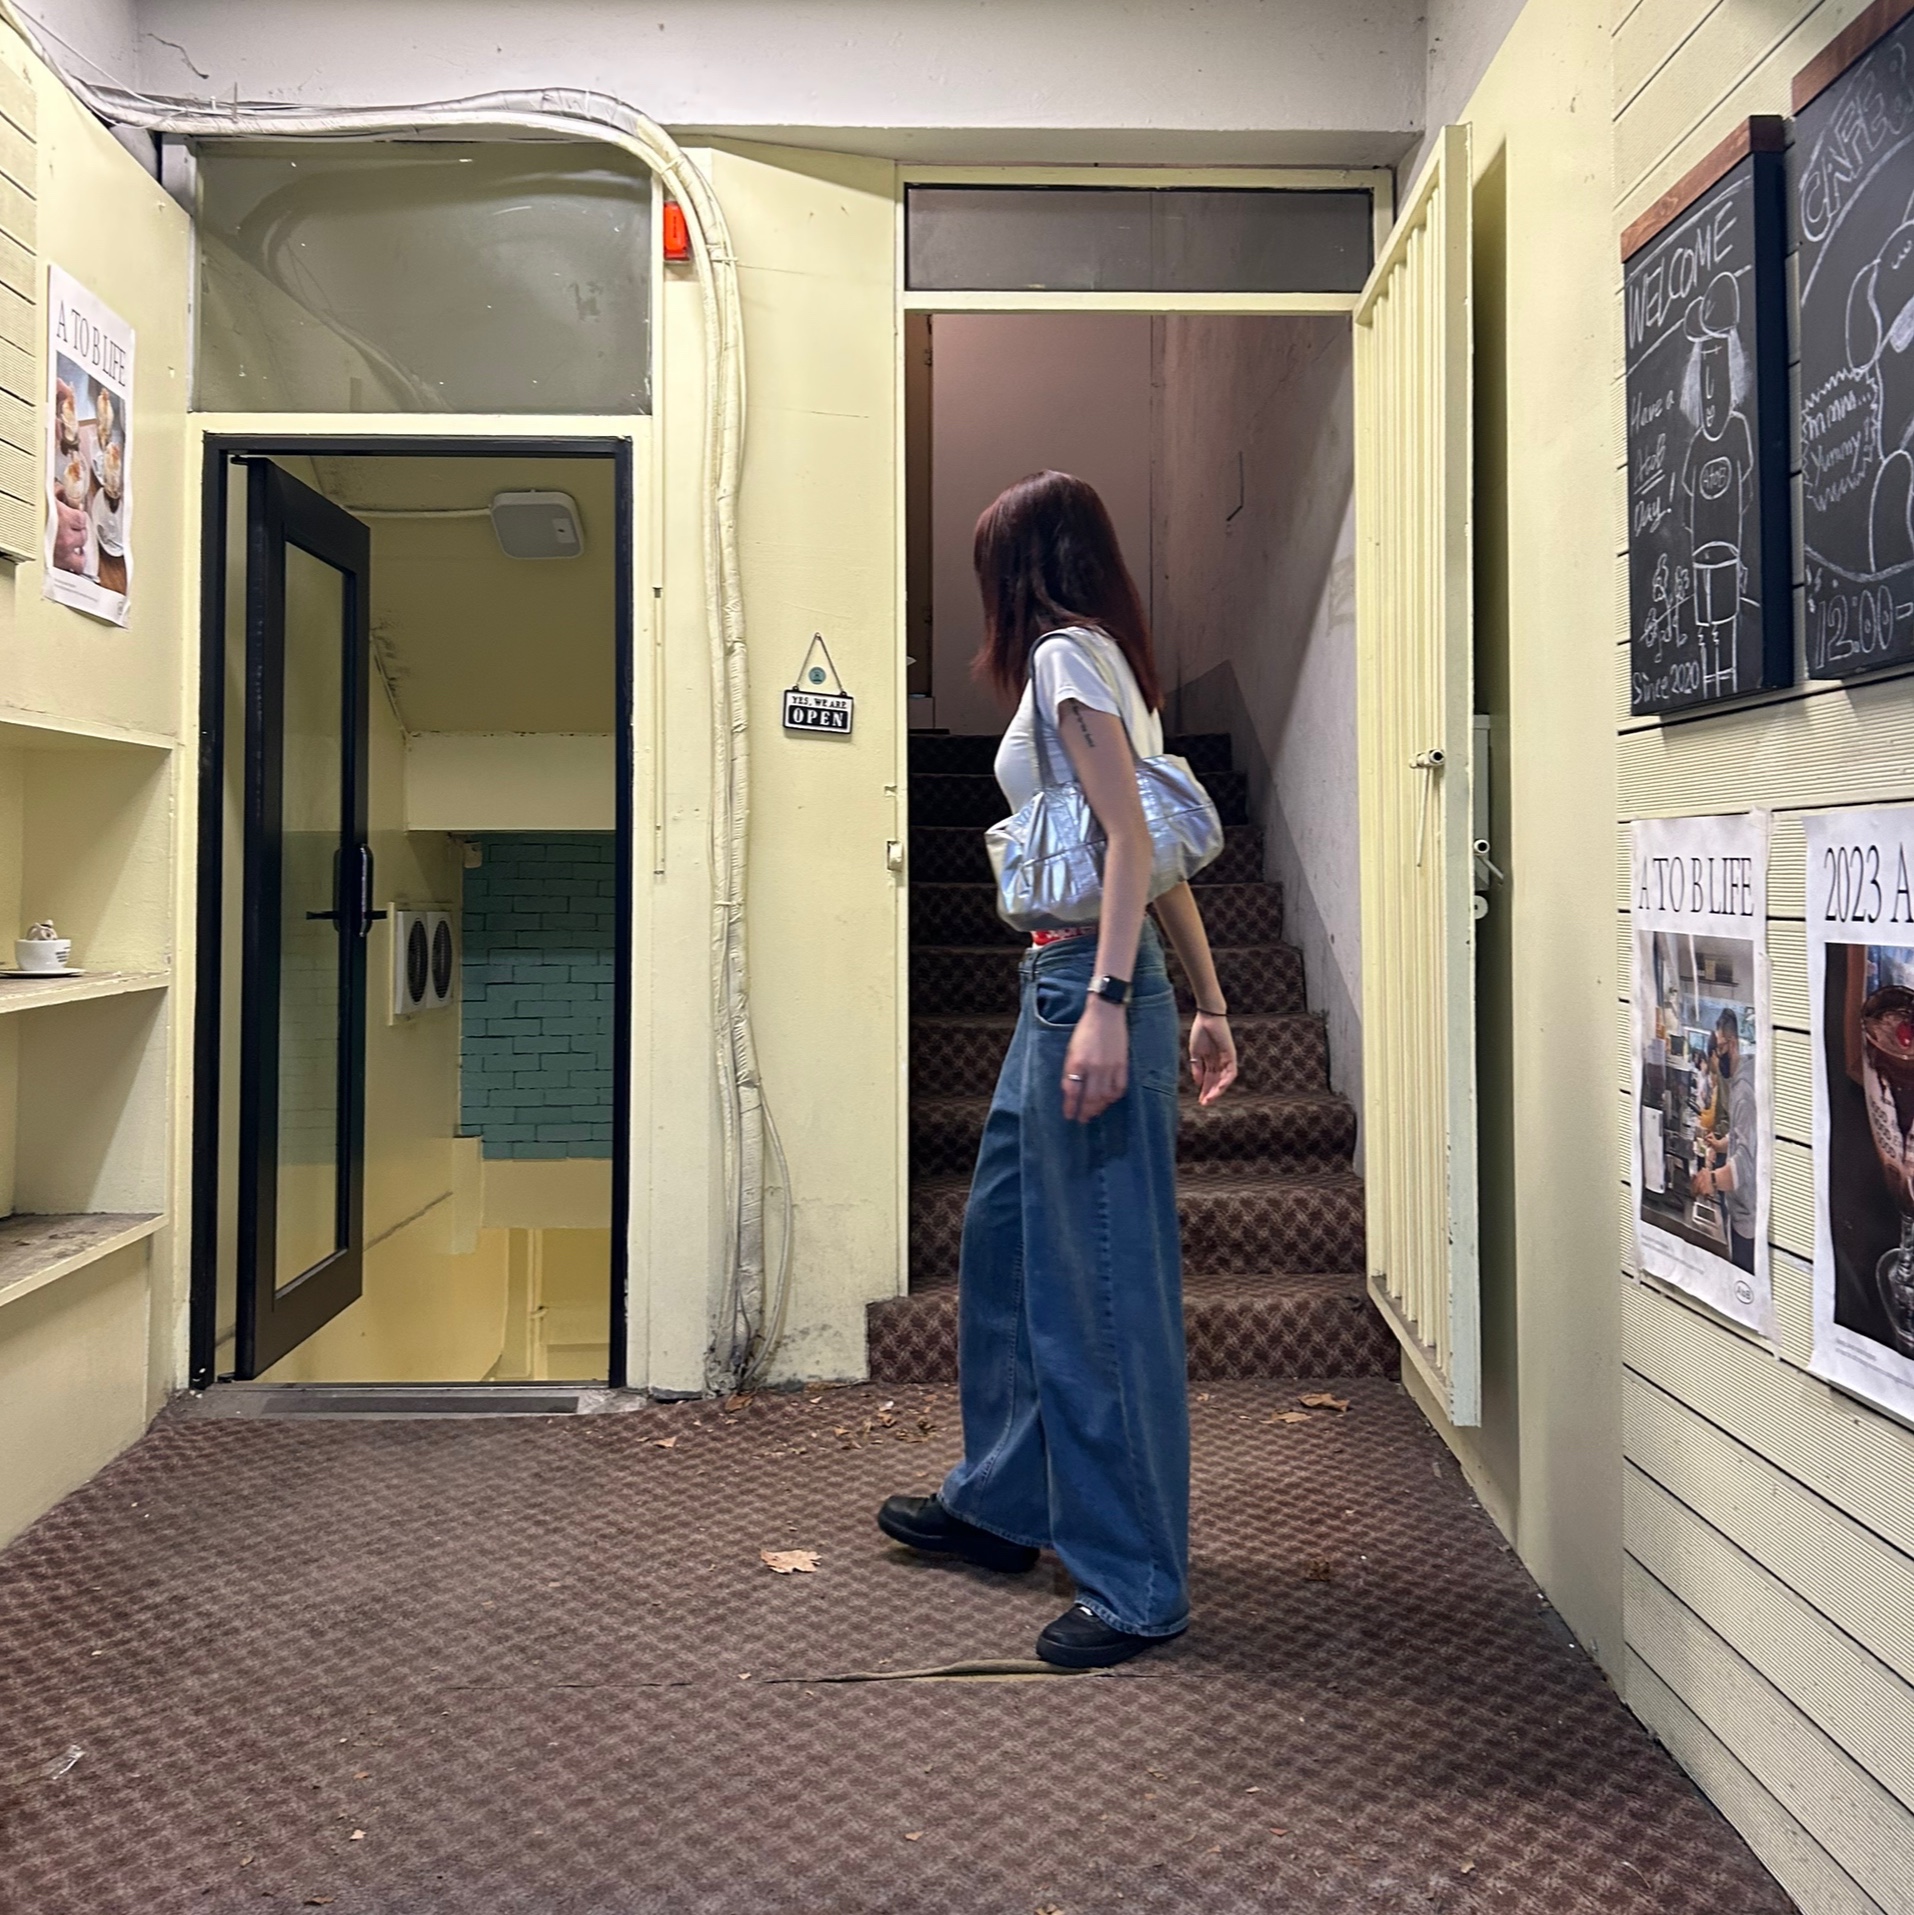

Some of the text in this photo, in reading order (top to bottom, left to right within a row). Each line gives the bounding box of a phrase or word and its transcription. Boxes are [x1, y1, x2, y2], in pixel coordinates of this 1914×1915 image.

[1629, 201, 1738, 350] WELCOME
[56, 300, 126, 387] A TO B LIFE
[1630, 389, 1675, 438] Have a
[792, 697, 847, 709] YES, WE ARE
[1633, 660, 1700, 705] Since 2020
[793, 708, 843, 727] OPEN
[1638, 856, 1755, 917] A TO B LIFE
[1823, 845, 1882, 924] 2023
